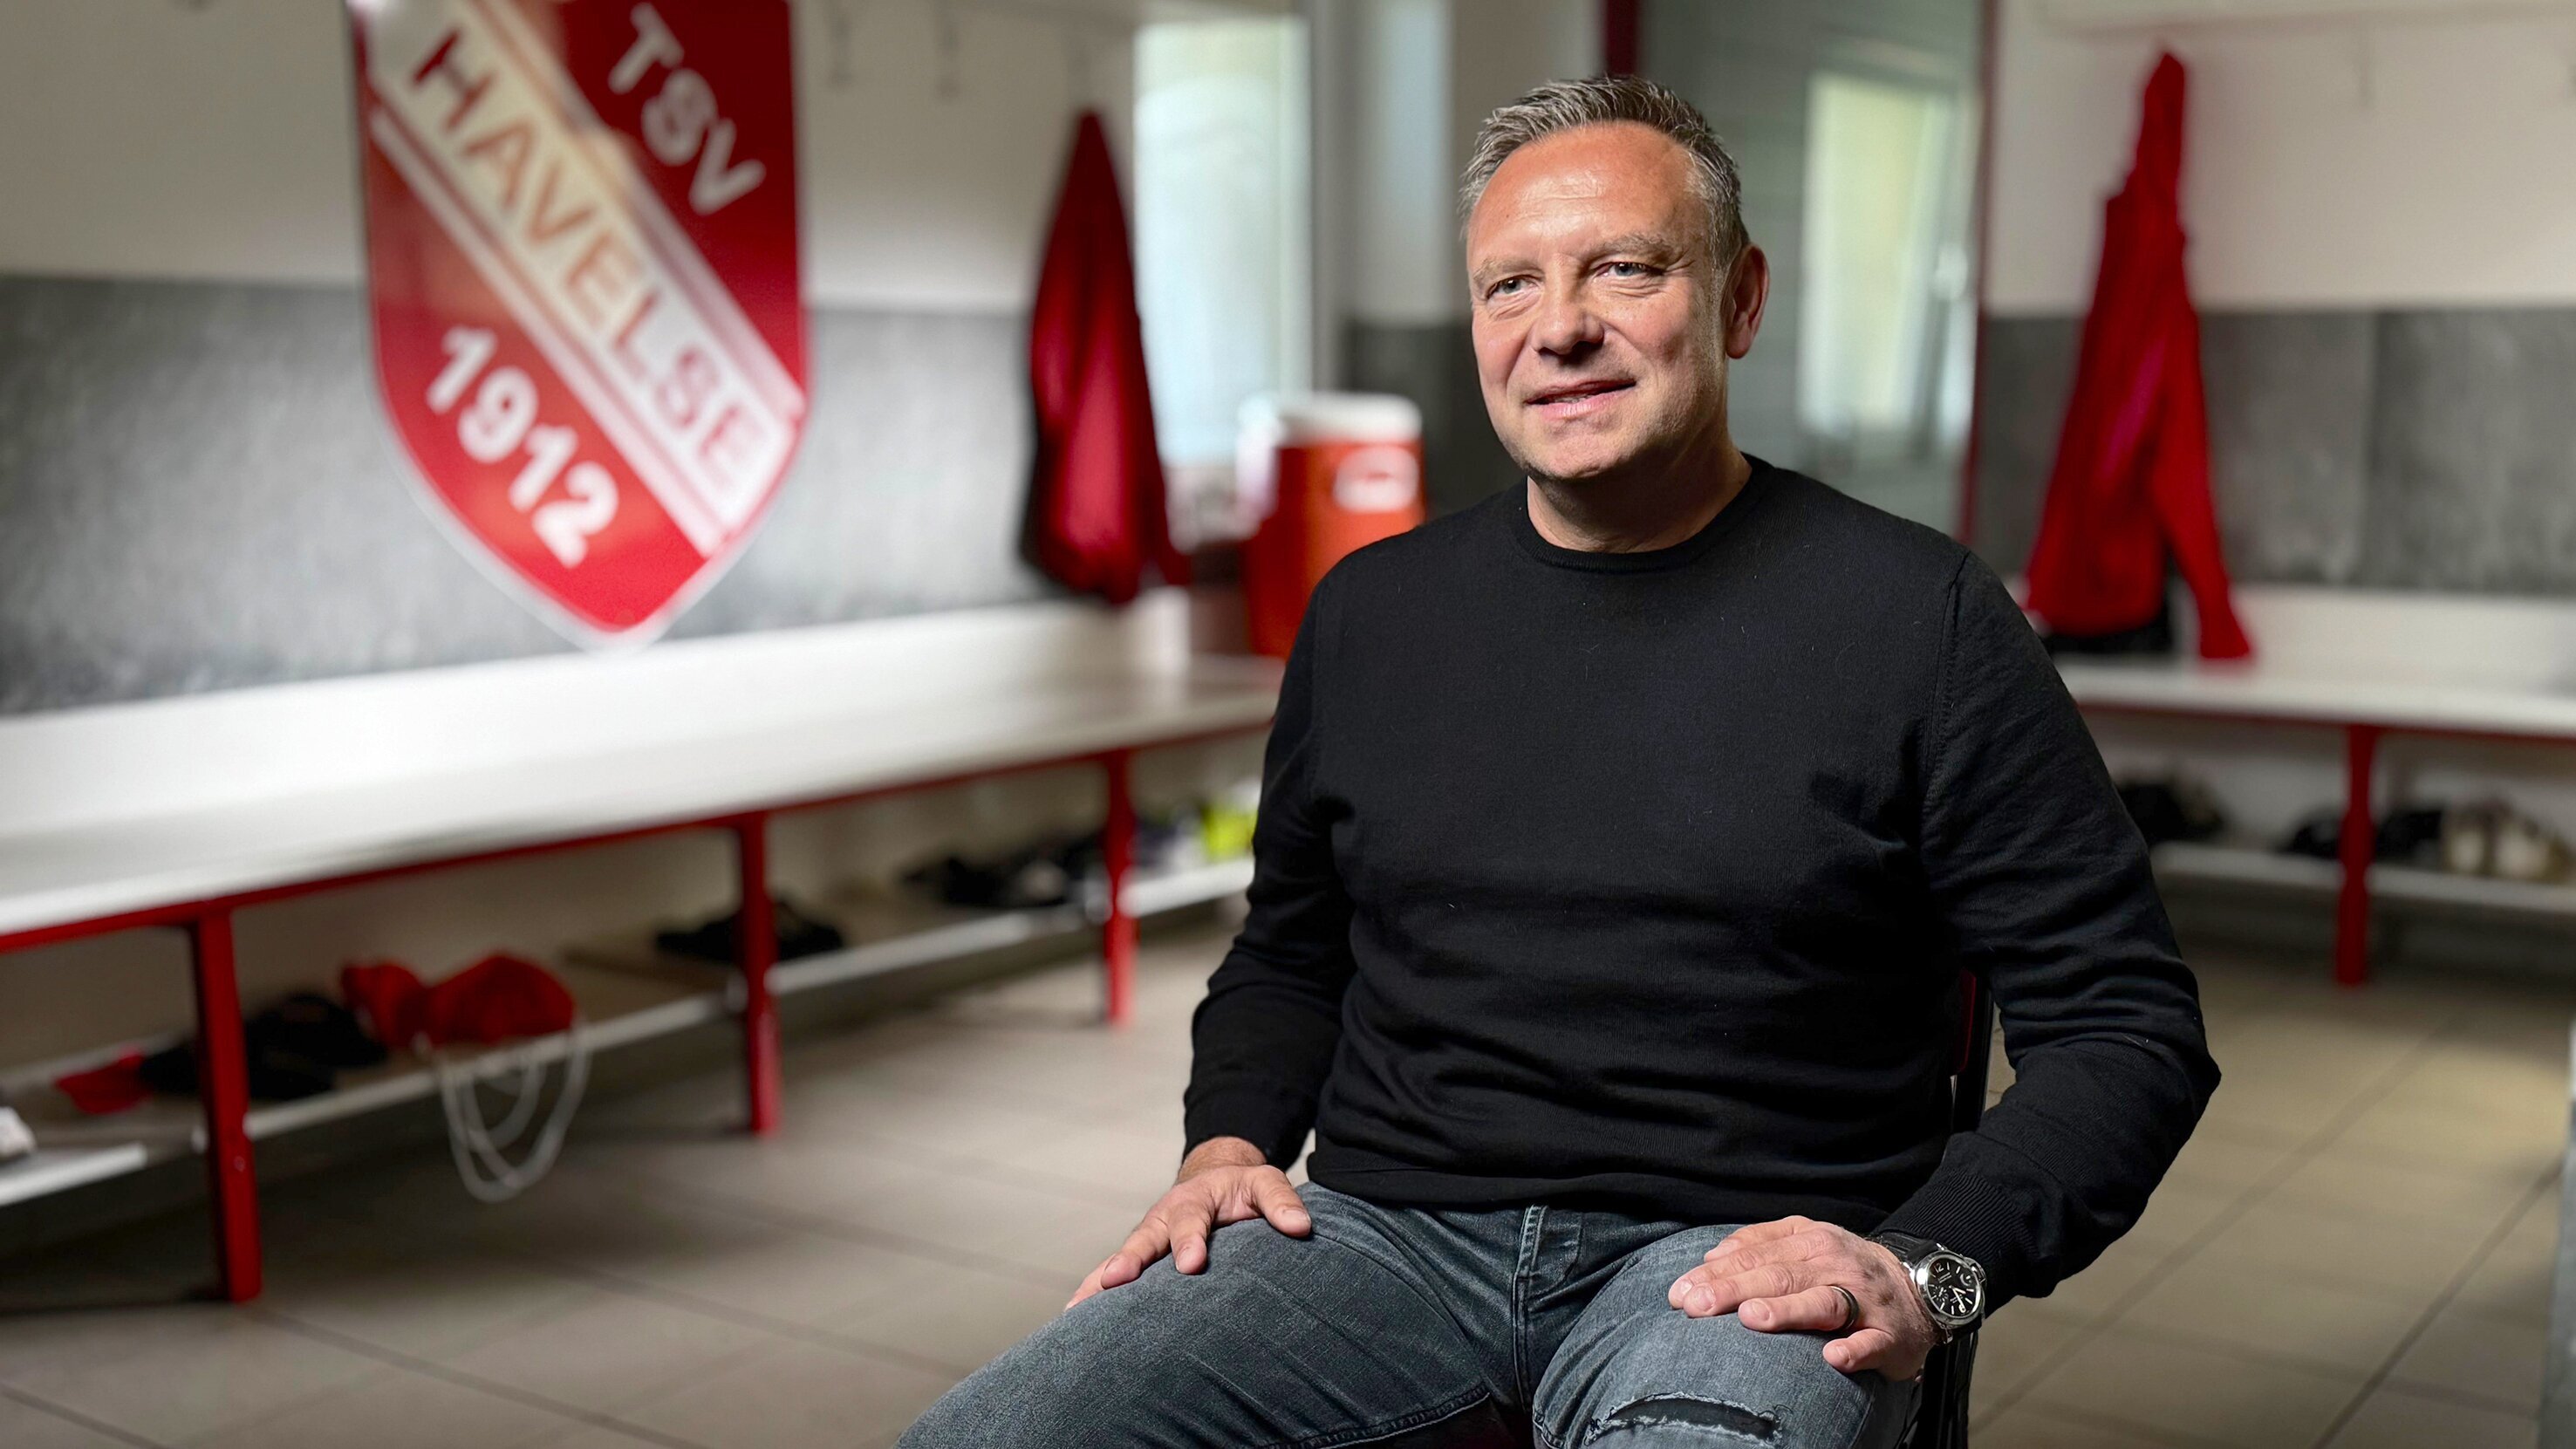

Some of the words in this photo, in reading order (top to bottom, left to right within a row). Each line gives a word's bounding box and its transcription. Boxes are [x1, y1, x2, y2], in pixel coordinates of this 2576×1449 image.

[607, 3, 767, 215] TSV
[413, 30, 757, 485] HAVELSE
[426, 326, 620, 569] 1912
[1934, 1262, 1944, 1274] 12
